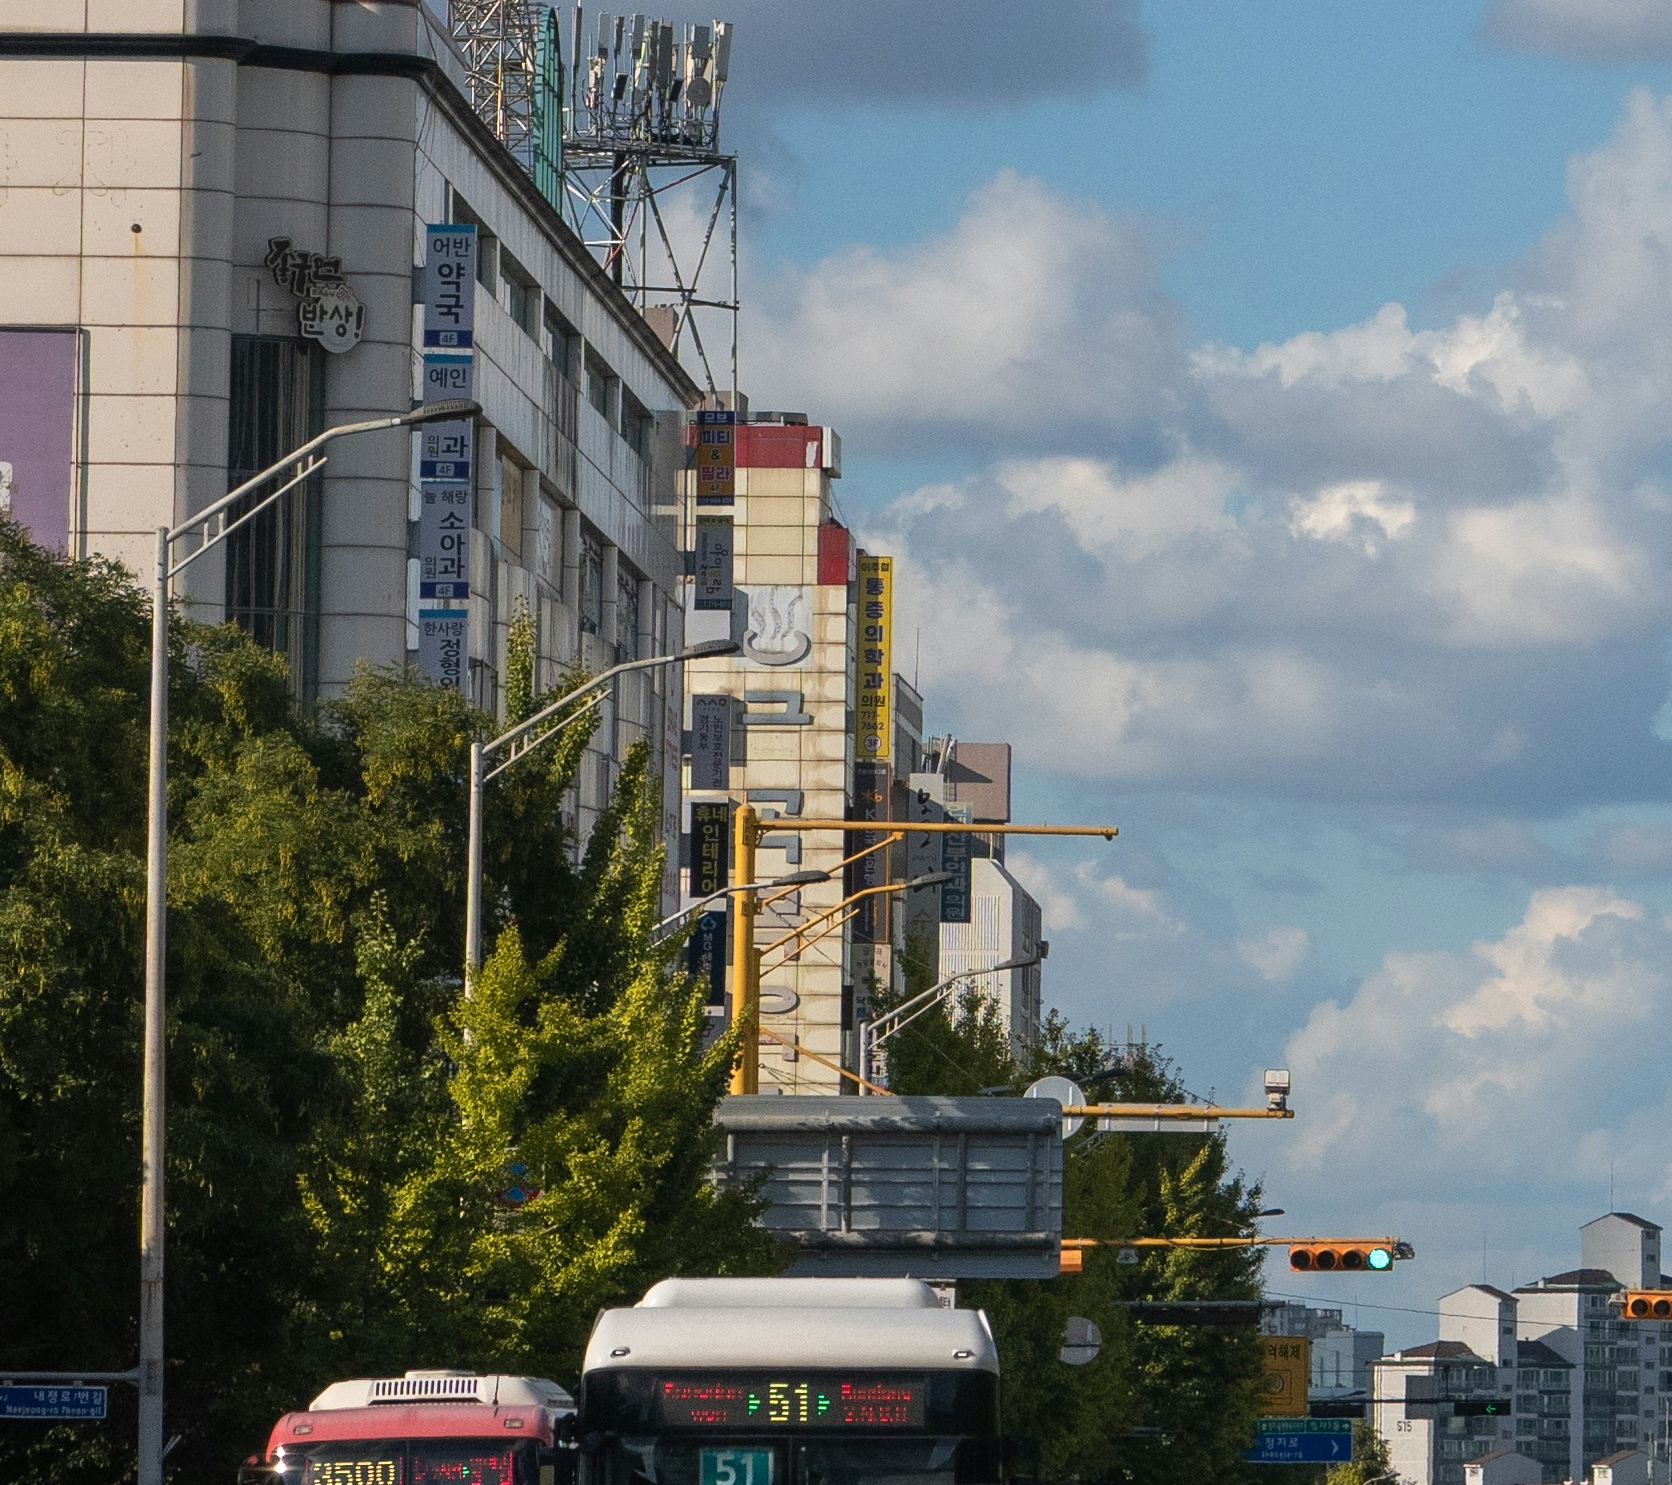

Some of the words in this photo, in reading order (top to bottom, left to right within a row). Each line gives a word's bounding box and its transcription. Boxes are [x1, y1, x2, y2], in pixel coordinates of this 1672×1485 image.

[433, 237, 471, 258] 어반
[435, 263, 466, 324] 약국
[302, 303, 363, 338] 반상!
[442, 332, 456, 345] 4F
[429, 368, 467, 389] 예인
[702, 430, 730, 445] 피티
[710, 449, 720, 460] &
[438, 464, 452, 475] 4F
[701, 467, 730, 481] 필라
[424, 490, 437, 505] 늘
[439, 511, 466, 578] 소아과
[438, 585, 451, 596] 4F
[424, 622, 464, 637] 한사랑
[864, 577, 884, 689] 통증의학과
[861, 696, 885, 706] 의원
[861, 721, 885, 730] 7662
[695, 805, 727, 821] 휴네
[702, 825, 720, 893] 인테리어
[1267, 1345, 1301, 1360] 역해제
[769, 1383, 808, 1422] 51
